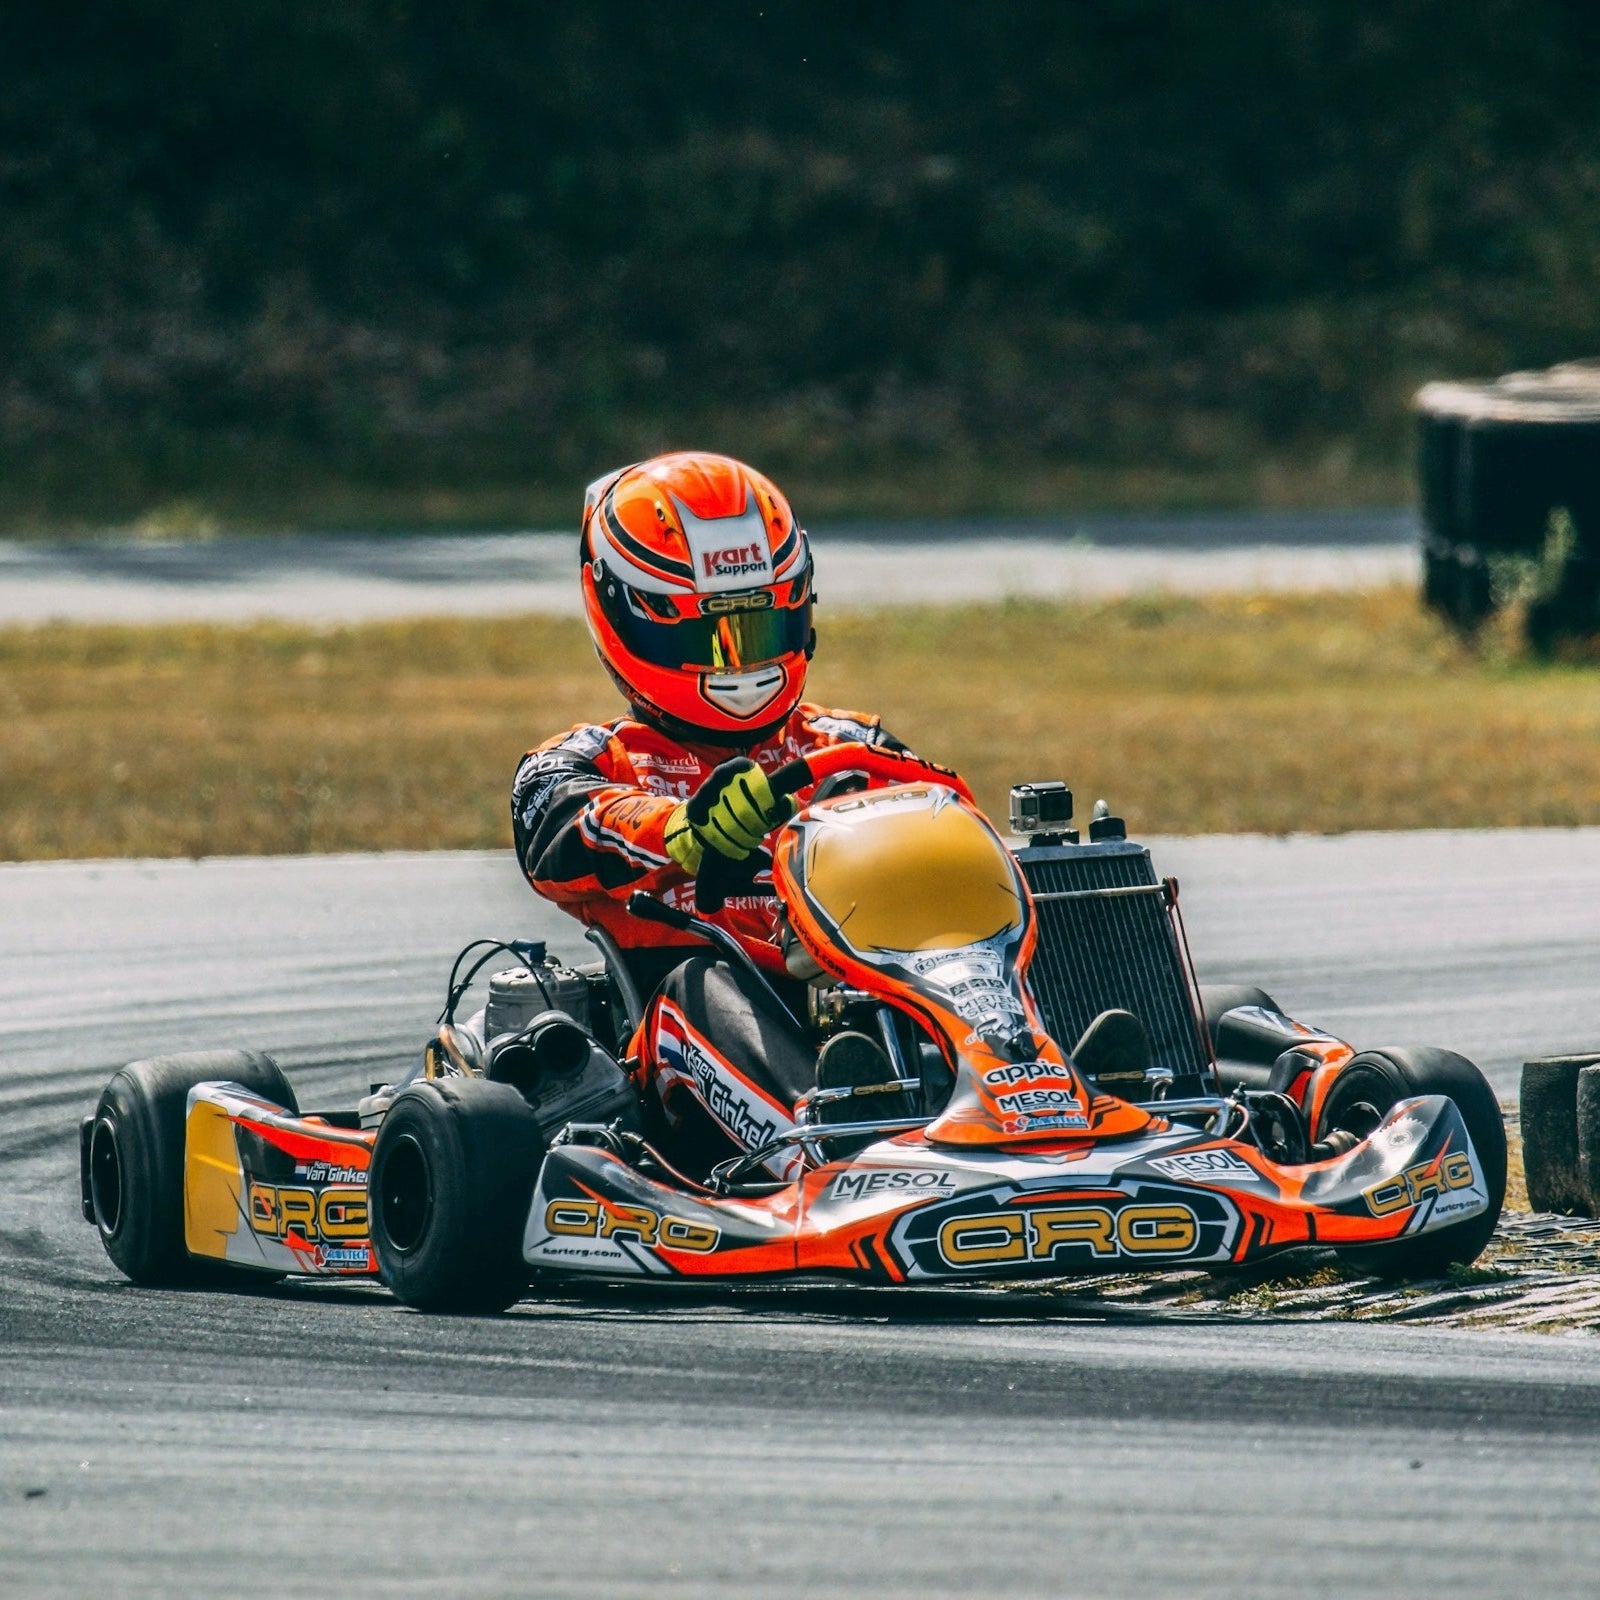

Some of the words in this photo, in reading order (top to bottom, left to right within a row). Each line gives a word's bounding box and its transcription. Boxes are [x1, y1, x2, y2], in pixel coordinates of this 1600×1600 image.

[703, 543, 762, 577] Kart
[716, 561, 768, 576] Support
[708, 594, 768, 611] CRG
[833, 790, 928, 813] CRG
[958, 993, 1016, 1013] MISTER
[967, 1001, 1018, 1017] SEVEN
[690, 1046, 716, 1082] Koen
[986, 1060, 1066, 1084] appic
[853, 1083, 902, 1096] CRG
[1000, 1091, 1079, 1112] MESOL
[710, 1083, 772, 1150] Ginkel
[306, 1165, 327, 1181] Van
[1153, 1152, 1248, 1179] MESOL
[834, 1172, 956, 1200] MESOL
[1362, 1153, 1474, 1217] CRG
[250, 1184, 370, 1241] CRG
[546, 1200, 720, 1254] CRG
[939, 1204, 1198, 1267] CRG
